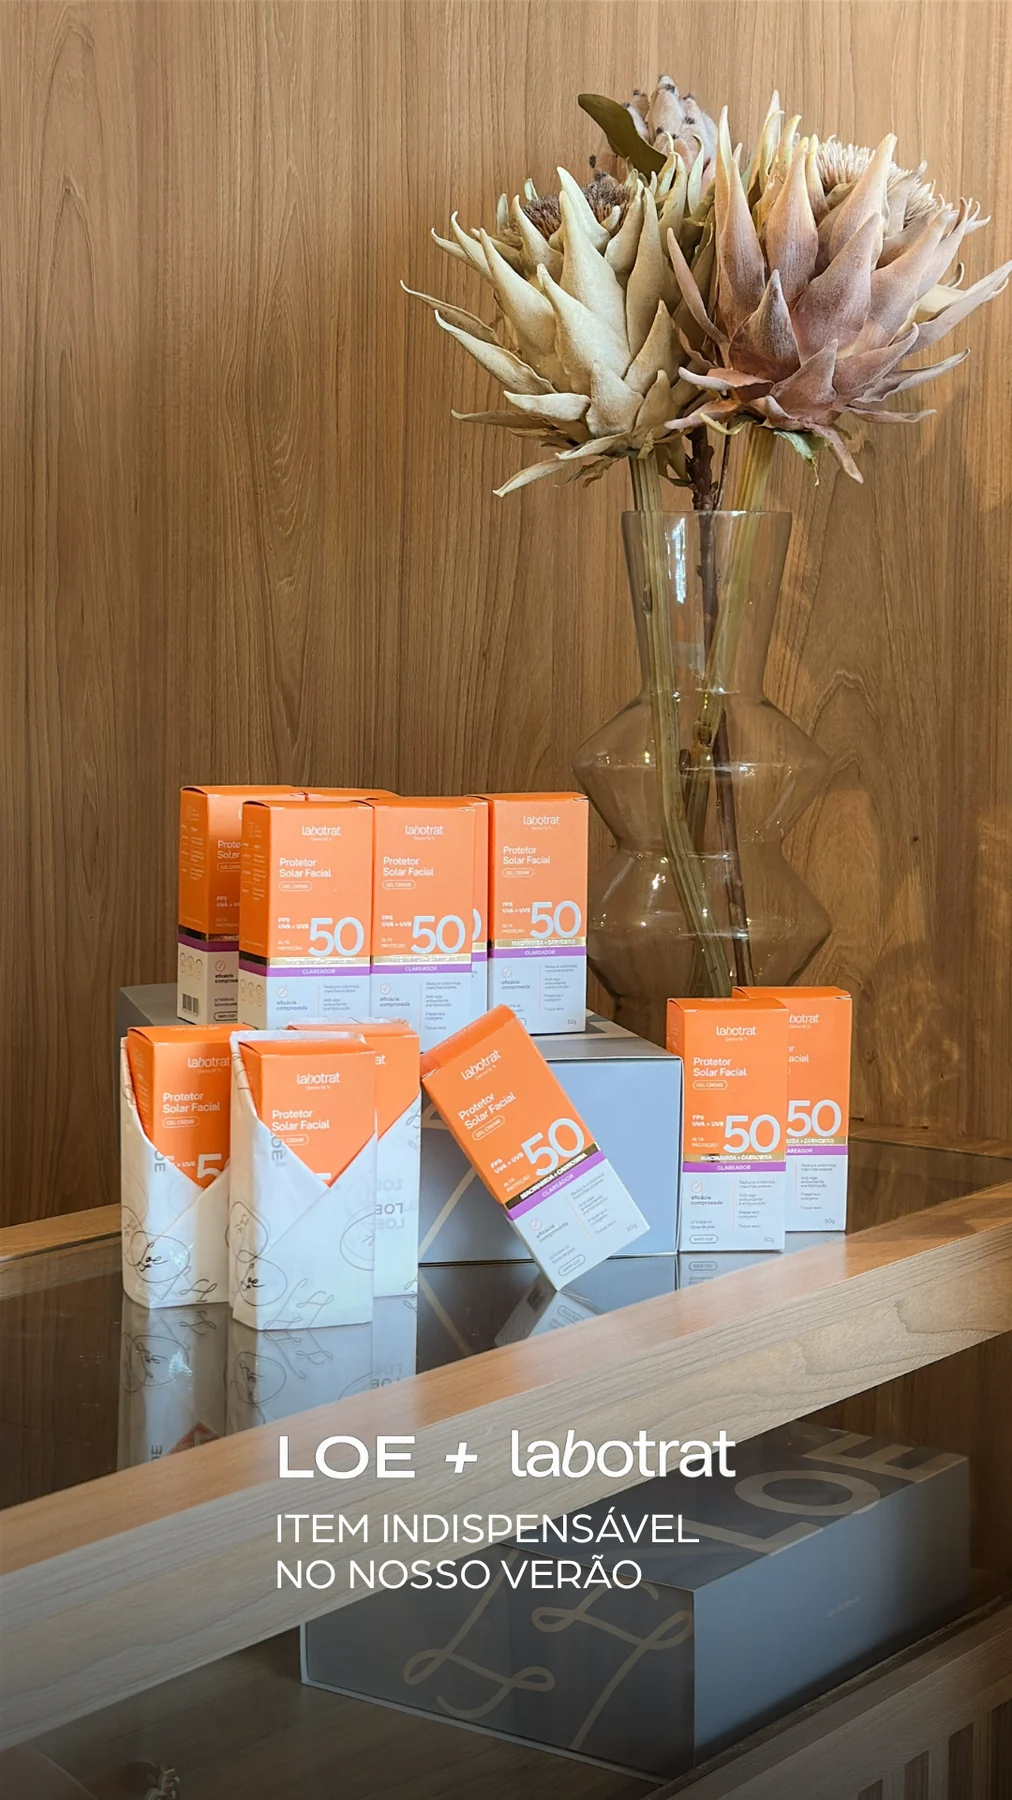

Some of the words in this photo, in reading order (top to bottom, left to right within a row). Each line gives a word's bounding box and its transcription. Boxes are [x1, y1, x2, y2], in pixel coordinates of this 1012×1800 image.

[523, 815, 560, 825] labotrat
[301, 825, 342, 837] labotrat
[405, 825, 444, 836] labotrat
[217, 840, 241, 849] Prote
[503, 846, 537, 854] Protetor
[217, 851, 240, 859] Solar
[503, 856, 525, 865] Solar
[526, 856, 551, 864] Facial
[279, 857, 317, 867] Protetor
[383, 856, 420, 866] Protetor
[279, 868, 304, 878] Solar
[305, 868, 332, 878] Facial
[383, 867, 407, 877] Solar
[408, 867, 434, 877] Facial
[530, 900, 582, 939] 50
[307, 916, 365, 957] 50
[410, 914, 466, 954] 50
[789, 1013, 820, 1024] botrat
[716, 1026, 757, 1036] labotrat
[187, 1056, 230, 1069] labotrat
[461, 1049, 502, 1080] labotrat
[693, 1057, 732, 1066] Protetor
[788, 1055, 809, 1063] acial
[693, 1067, 717, 1077] Solar
[719, 1067, 747, 1077] Facial
[296, 1071, 340, 1085] labotrat
[163, 1091, 204, 1102] Protetor
[162, 1103, 189, 1114] Solar
[191, 1102, 221, 1112] Facial
[458, 1093, 495, 1120] Protetor
[465, 1111, 489, 1130] Solar
[488, 1091, 516, 1113] Facial
[272, 1109, 313, 1120] Protetor
[786, 1099, 842, 1137] 50
[272, 1121, 298, 1132] Solar
[300, 1120, 330, 1130] Facial
[723, 1114, 781, 1154] 50
[271, 1133, 283, 1160] OE
[521, 1117, 585, 1177] 50
[154, 1150, 166, 1173] OE
[490, 1158, 504, 1169] FPS
[494, 1164, 508, 1174] UVA
[511, 1151, 525, 1163] UVB
[542, 1173, 574, 1197] CLAREADOR
